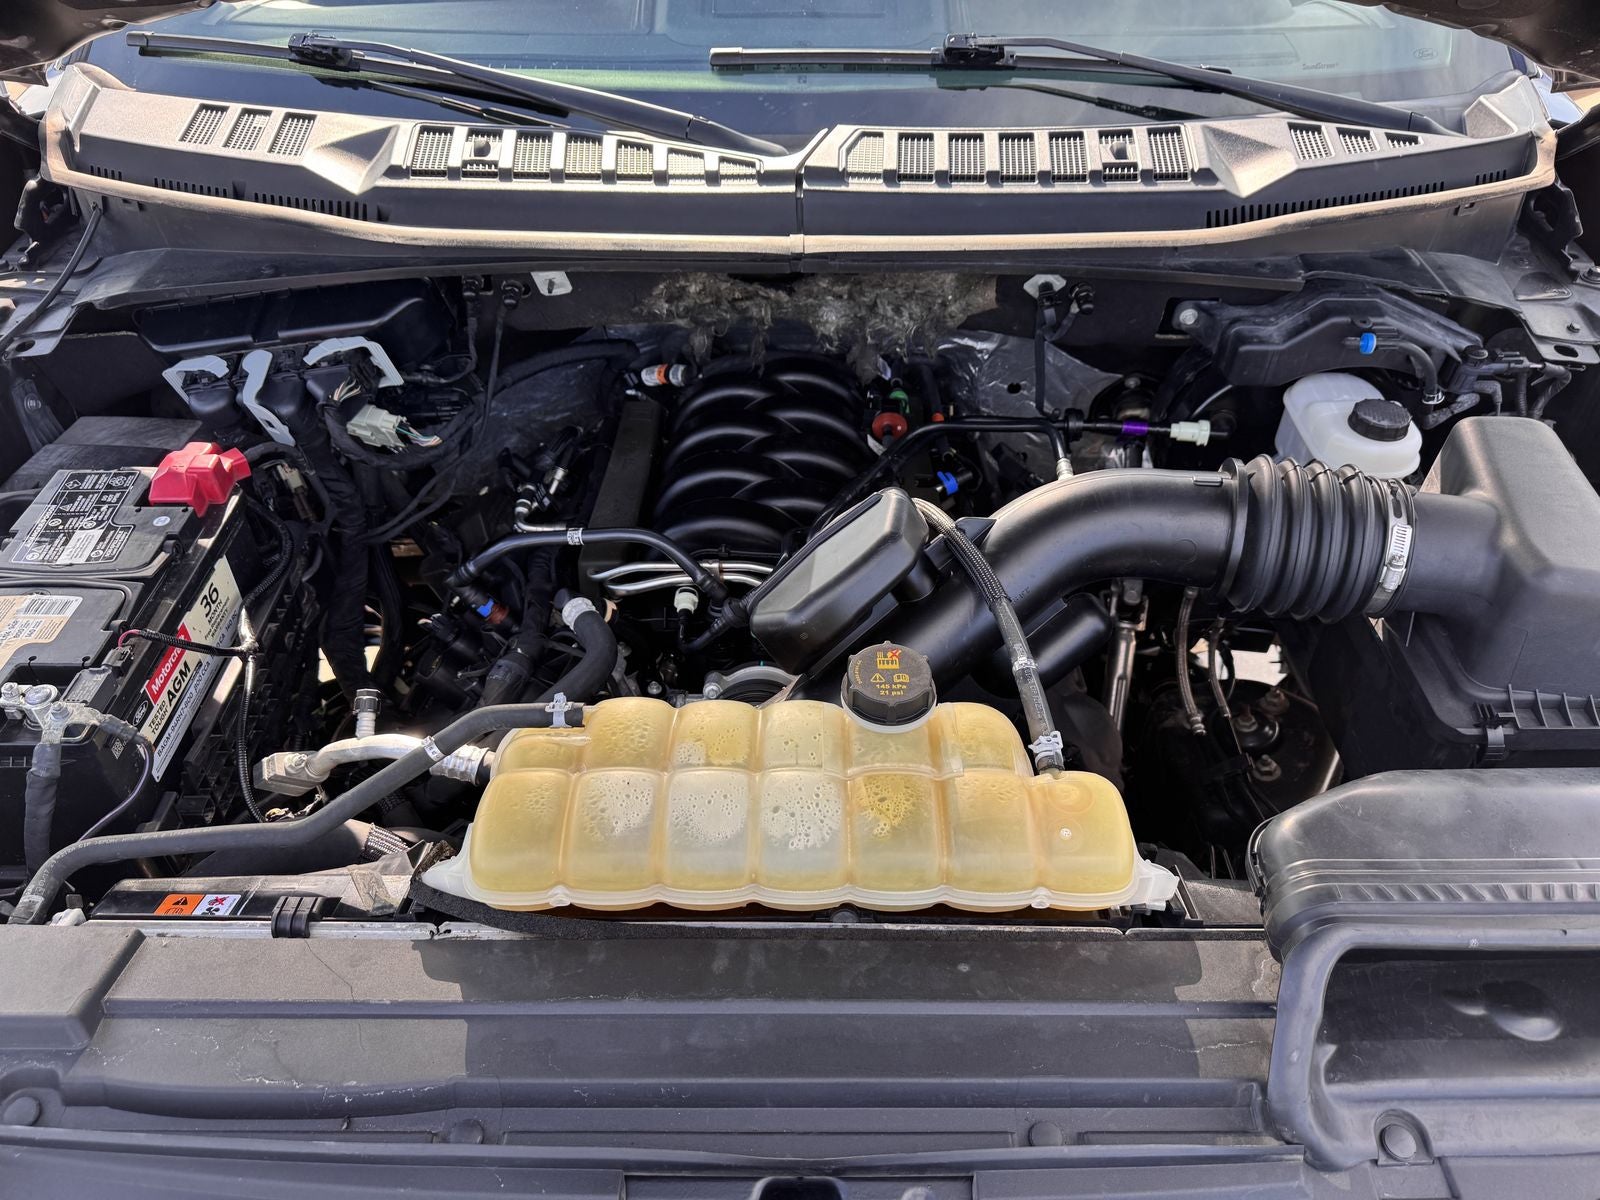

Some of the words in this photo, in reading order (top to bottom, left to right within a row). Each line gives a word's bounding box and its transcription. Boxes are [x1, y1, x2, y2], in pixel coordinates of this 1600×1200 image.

[200, 582, 219, 618] 36
[208, 598, 223, 626] MONTH
[151, 634, 185, 696] Motorcrat
[167, 660, 191, 708] AGM
[148, 701, 166, 729] TESTED
